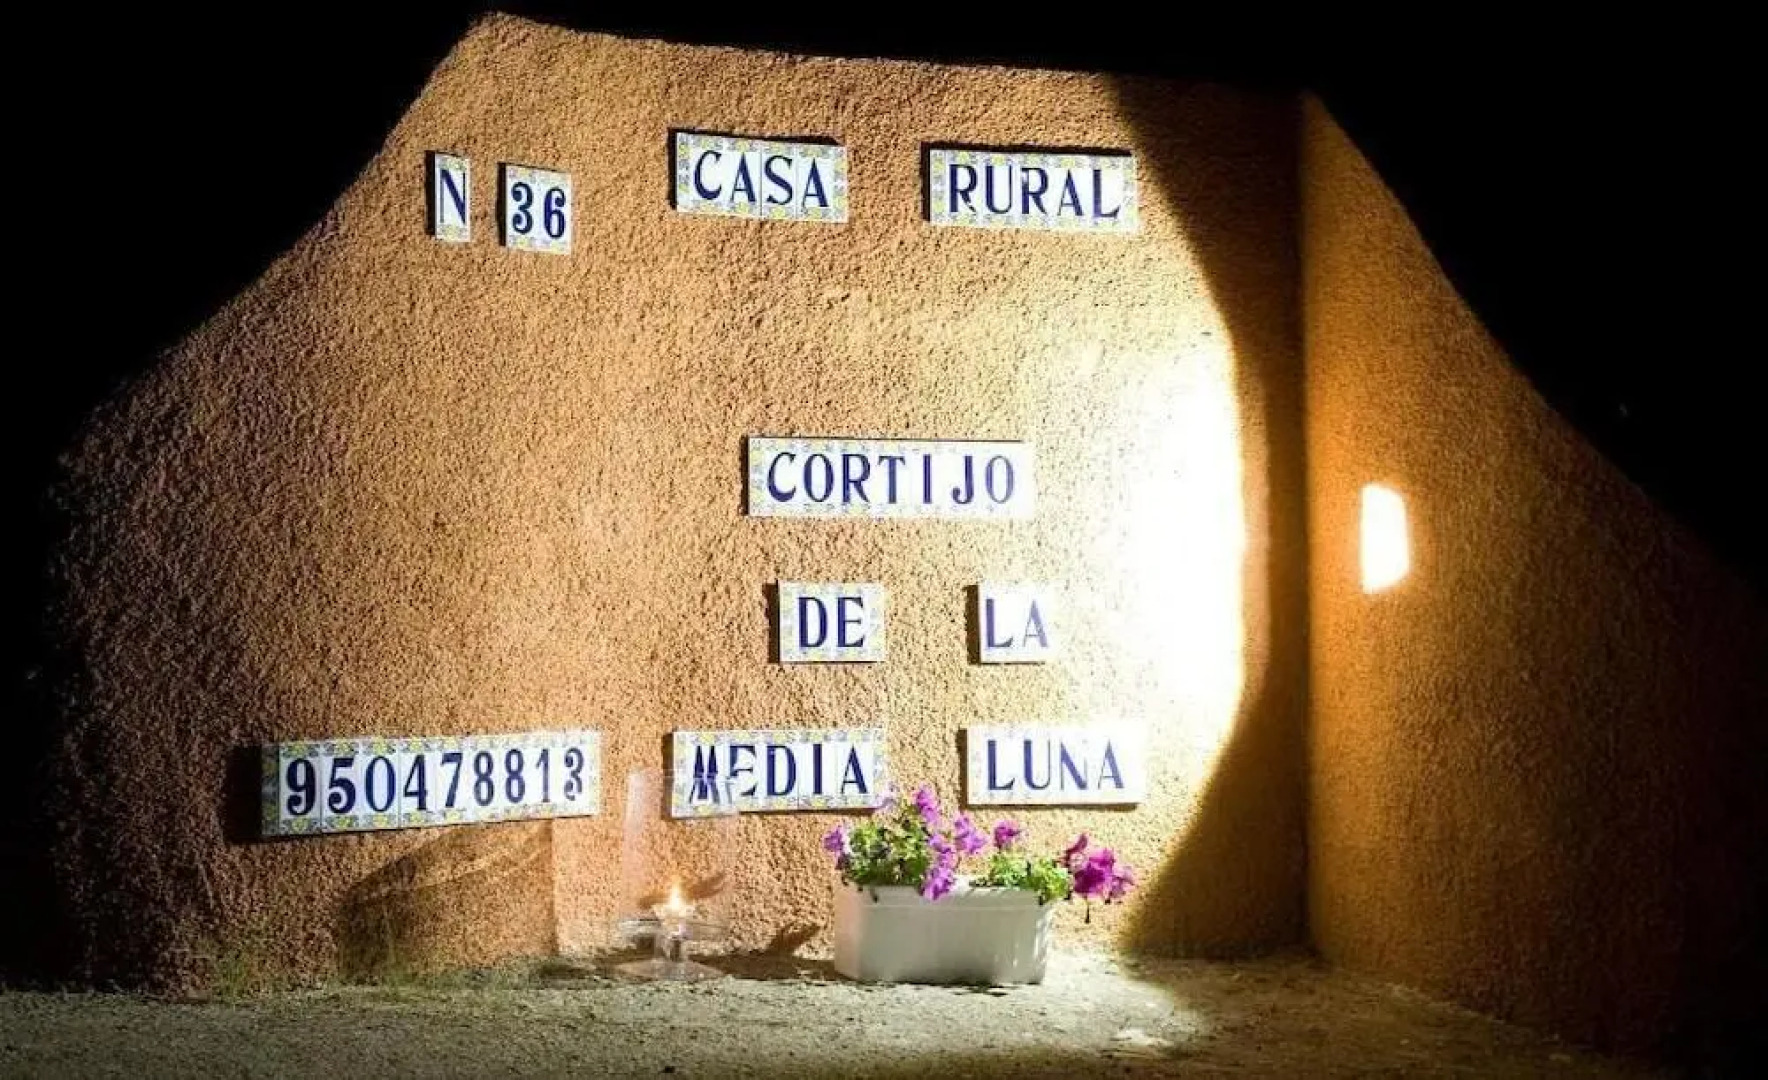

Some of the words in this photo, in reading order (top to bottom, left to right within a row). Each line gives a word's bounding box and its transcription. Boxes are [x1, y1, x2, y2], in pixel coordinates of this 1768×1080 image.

[439, 168, 466, 225] N
[511, 181, 566, 238] 36
[694, 150, 829, 208] CASA
[949, 163, 1120, 218] RURAL
[768, 451, 1015, 504] CORTIJO
[797, 596, 865, 648] DE
[986, 598, 1048, 648] LA
[286, 748, 584, 816] 950478813
[689, 743, 868, 803] MEDIA
[986, 739, 1124, 791] LUNA
